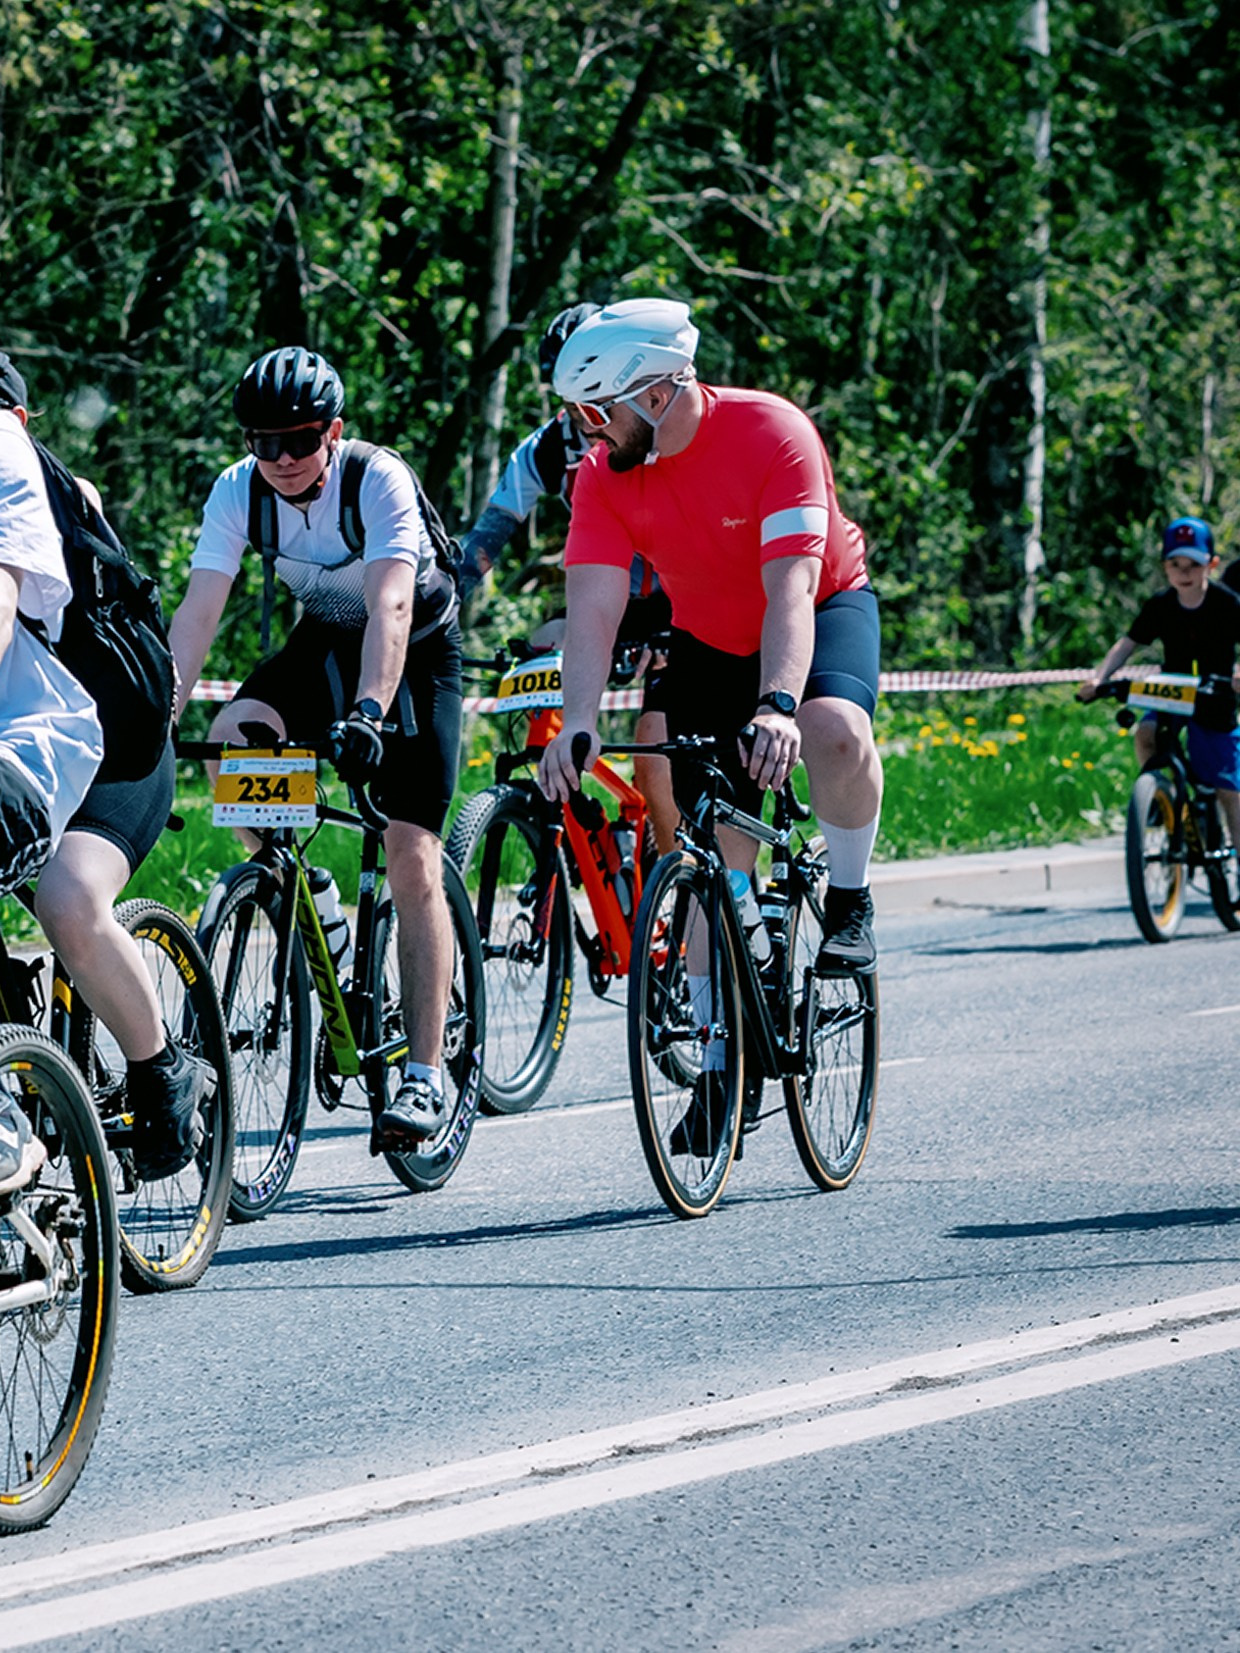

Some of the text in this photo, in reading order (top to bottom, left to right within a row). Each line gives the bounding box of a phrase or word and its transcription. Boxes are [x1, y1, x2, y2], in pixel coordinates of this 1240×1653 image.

[510, 670, 562, 696] 1018
[1142, 683, 1184, 700] 1165
[237, 776, 291, 802] 234
